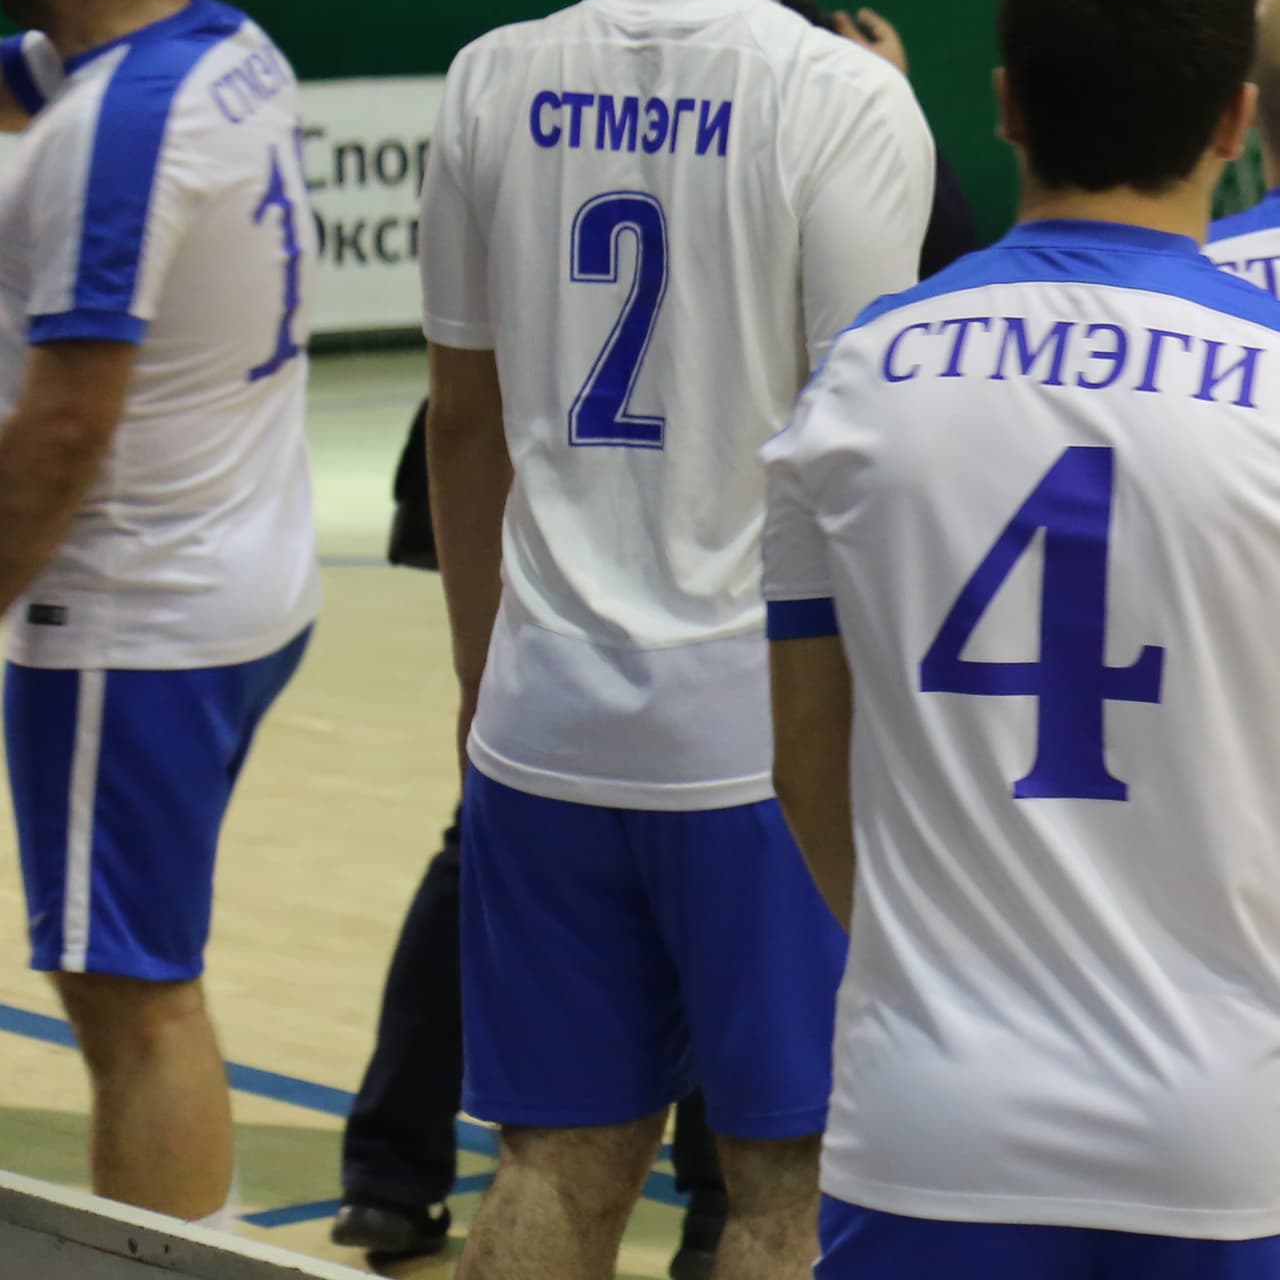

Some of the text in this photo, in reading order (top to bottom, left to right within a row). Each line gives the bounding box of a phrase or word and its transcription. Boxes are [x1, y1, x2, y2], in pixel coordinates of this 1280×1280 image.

[246, 116, 309, 383] 1
[529, 90, 733, 157] СТМЭГИ
[568, 190, 669, 449] 2
[882, 317, 1265, 410] СТМЭГИ
[920, 445, 1165, 801] 4
